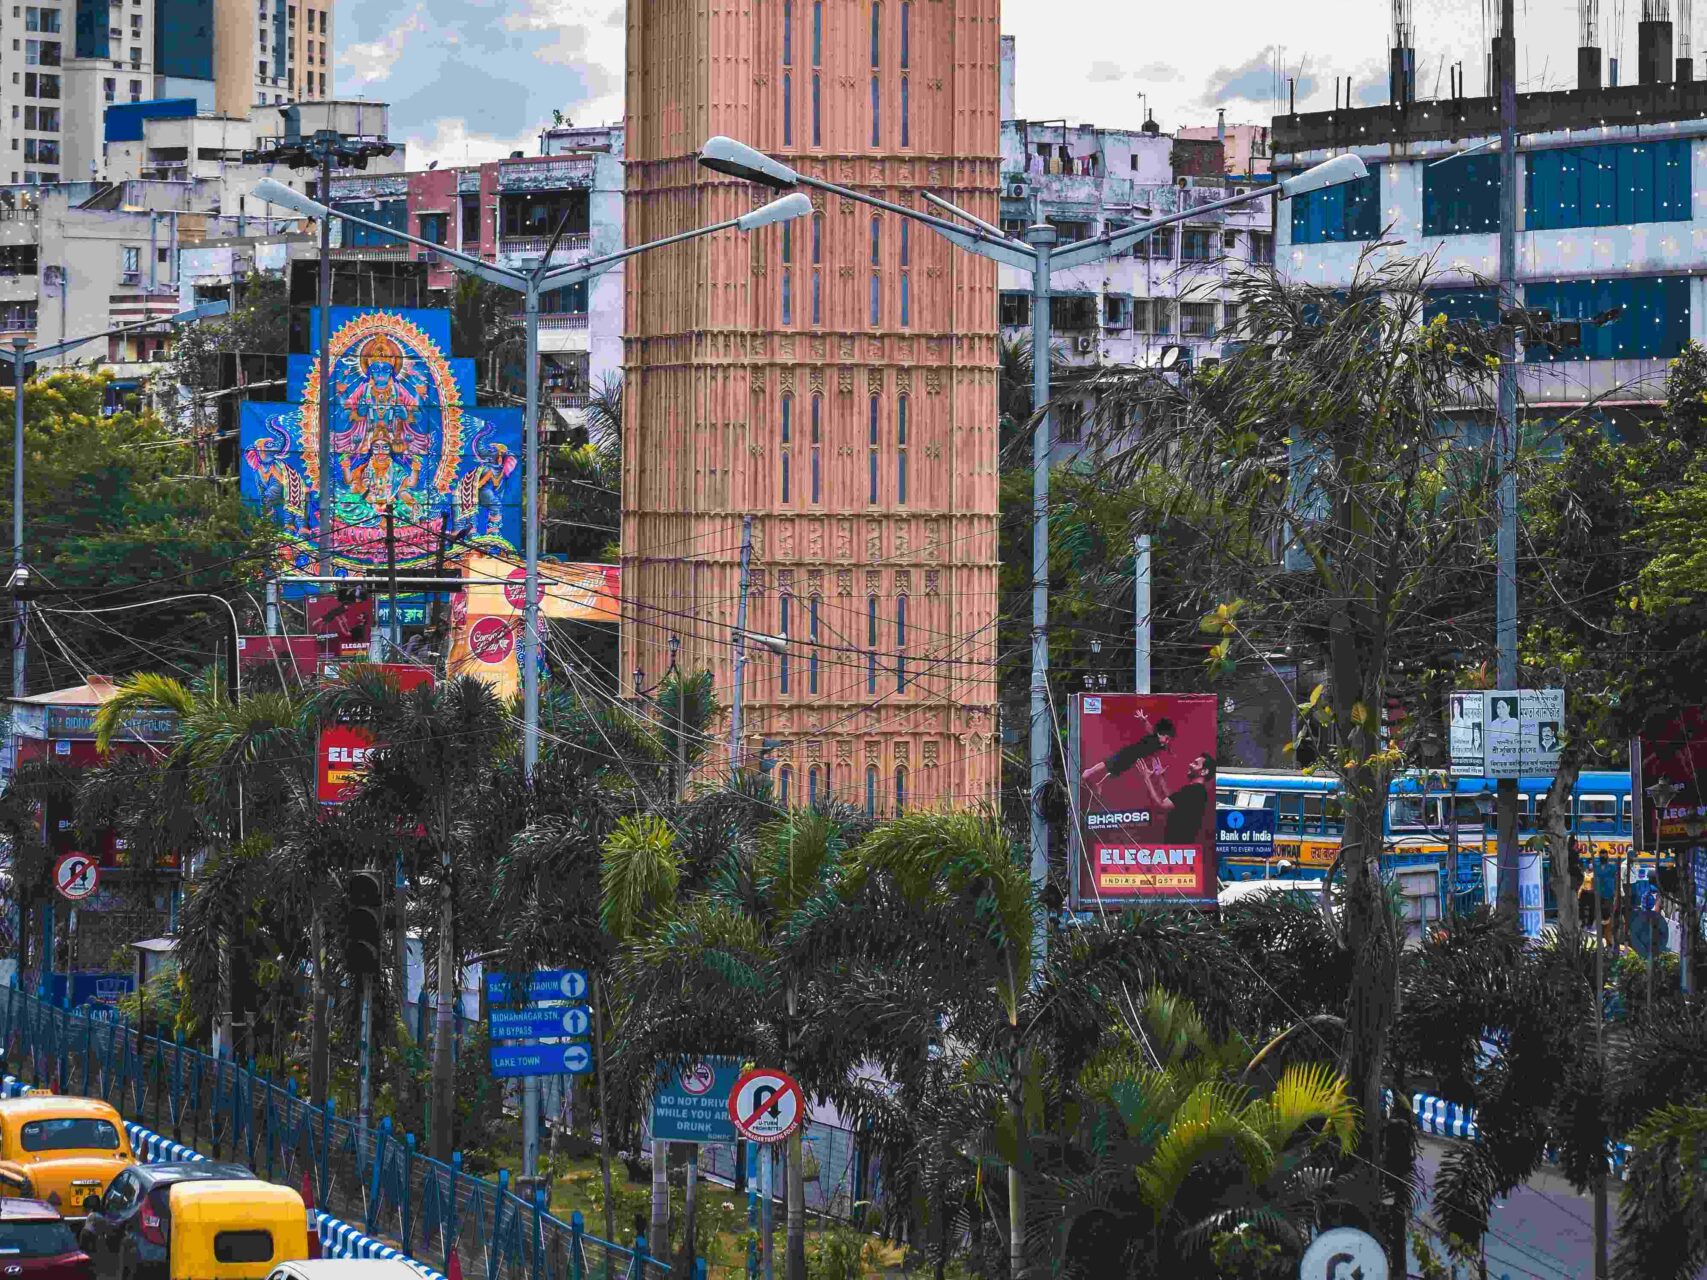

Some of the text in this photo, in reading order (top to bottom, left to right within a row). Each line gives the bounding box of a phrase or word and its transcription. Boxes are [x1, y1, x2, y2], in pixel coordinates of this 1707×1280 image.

[1087, 811, 1150, 825] BHAROSA
[1220, 829, 1271, 841] Bank of India
[1100, 848, 1196, 865] ELEGANT
[492, 1011, 560, 1023] BIDHANNAGAR STN.
[506, 1026, 533, 1036] BYPASS
[495, 1056, 540, 1067] LAKE TOWN
[660, 1095, 675, 1105] DO
[677, 1096, 698, 1106] NOT
[656, 1107, 729, 1120] WHILE YOU AR
[676, 1121, 712, 1132] DRUNK
